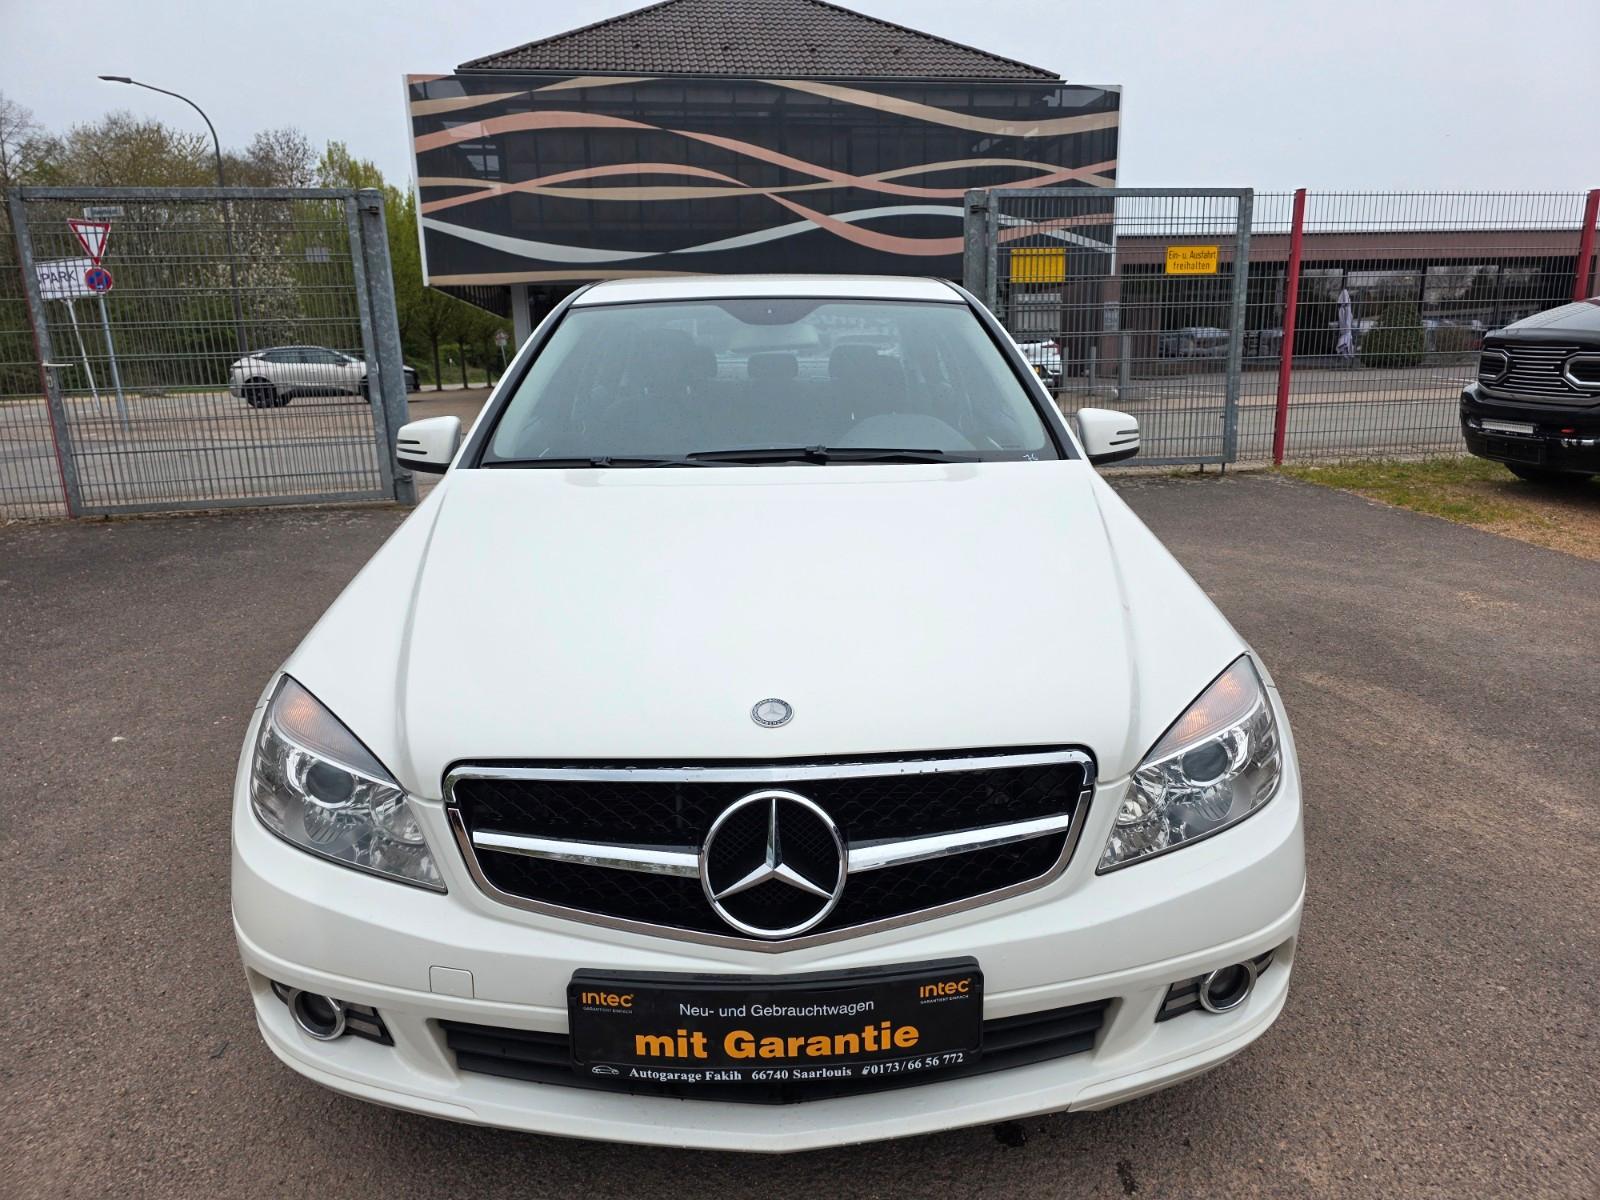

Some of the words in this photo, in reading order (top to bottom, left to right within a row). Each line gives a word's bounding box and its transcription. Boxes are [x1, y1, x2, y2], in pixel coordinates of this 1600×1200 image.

[1169, 250, 1181, 259] Ein-
[1190, 250, 1216, 260] Ausfahrt
[1173, 261, 1210, 270] freihalten
[40, 270, 77, 284] PARK
[920, 979, 970, 998] intec
[582, 991, 633, 1008] intec
[680, 1003, 715, 1017] Neu-
[719, 1004, 746, 1017] und
[751, 1001, 875, 1017] Gebrauchtwagen
[635, 1029, 708, 1059] mit
[724, 1020, 919, 1059] Garantie
[629, 1068, 702, 1083] Autogarage
[705, 1070, 742, 1081] Fakih
[751, 1070, 789, 1080] 66740
[793, 1067, 852, 1080] Saarlouis
[925, 1056, 940, 1068] 56
[943, 1052, 964, 1065] 772
